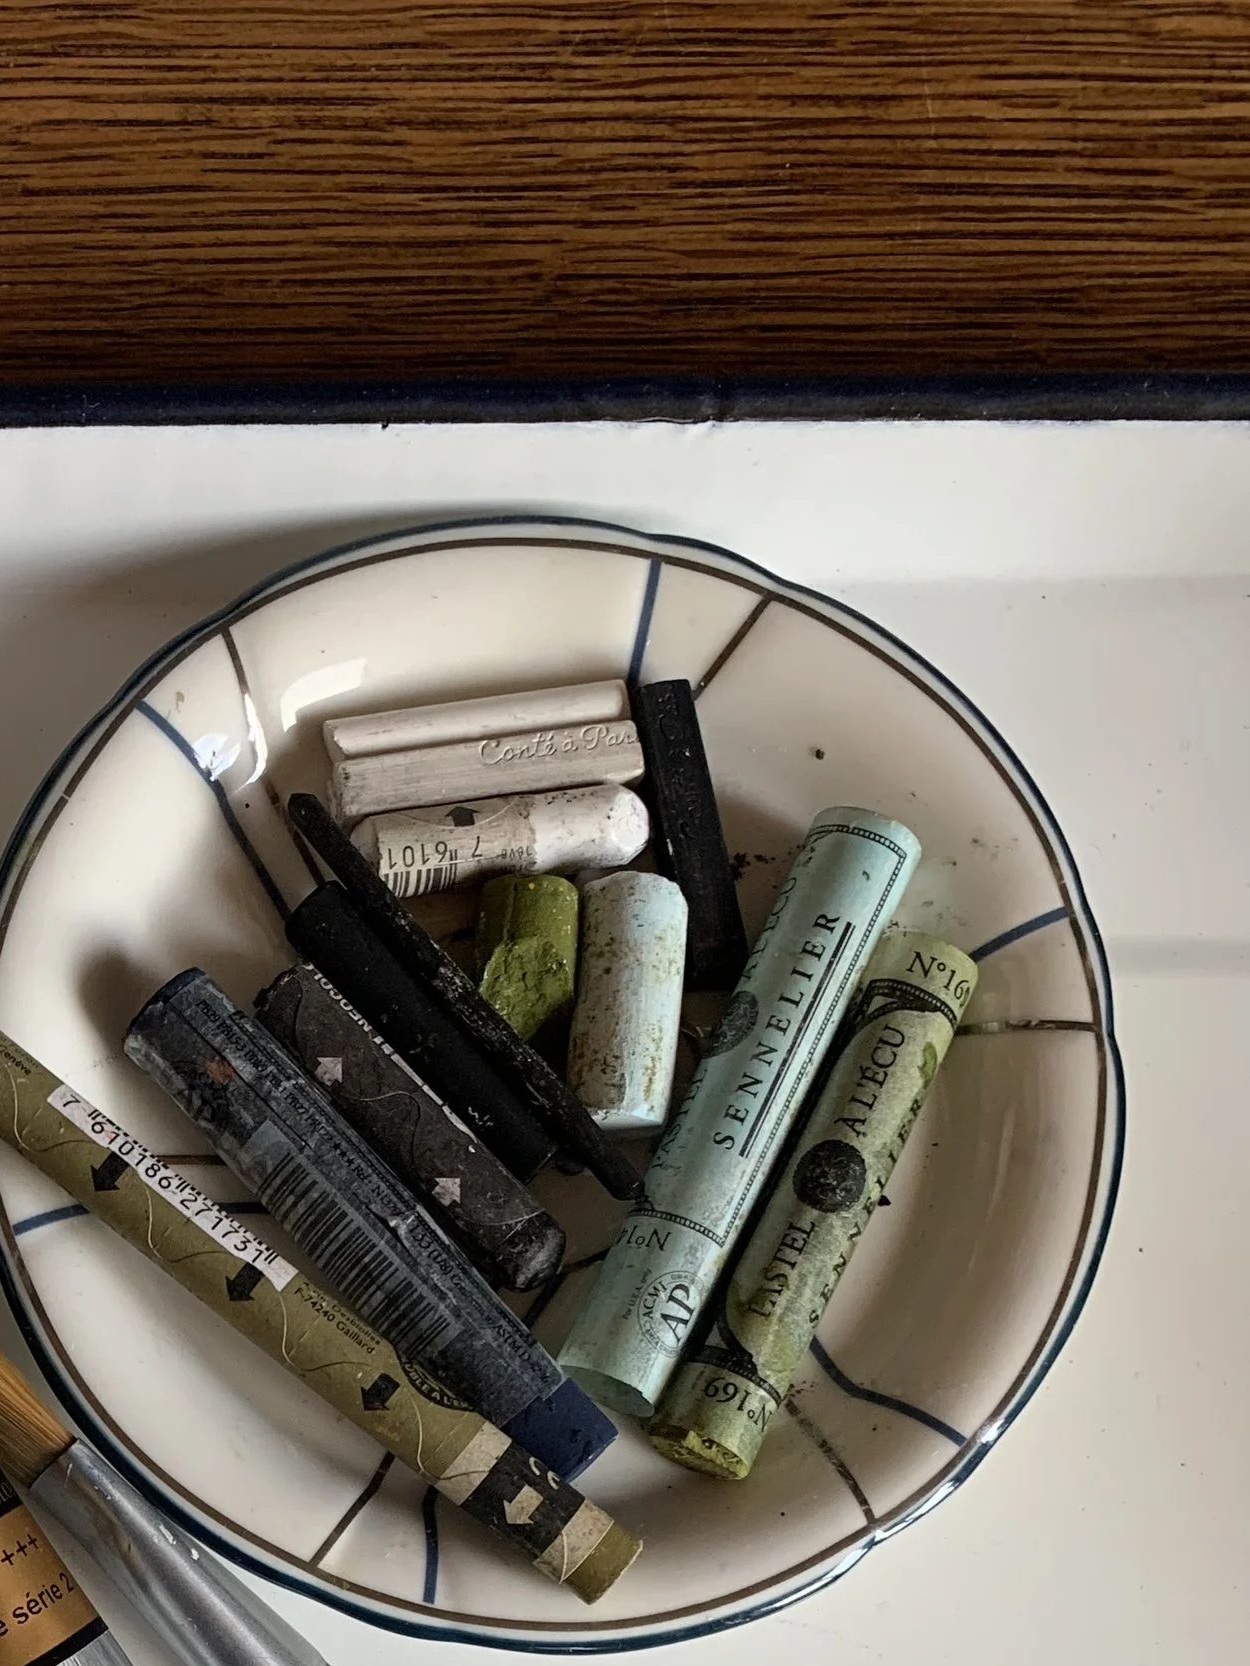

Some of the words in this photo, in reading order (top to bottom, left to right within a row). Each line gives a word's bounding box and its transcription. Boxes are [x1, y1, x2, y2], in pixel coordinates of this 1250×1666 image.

[713, 912, 841, 1150] SENNELIER
[335, 1320, 376, 1355] Gaillard
[660, 1283, 698, 1343] AP
[12, 1583, 64, 1625] série
[59, 1573, 76, 1594] 2
